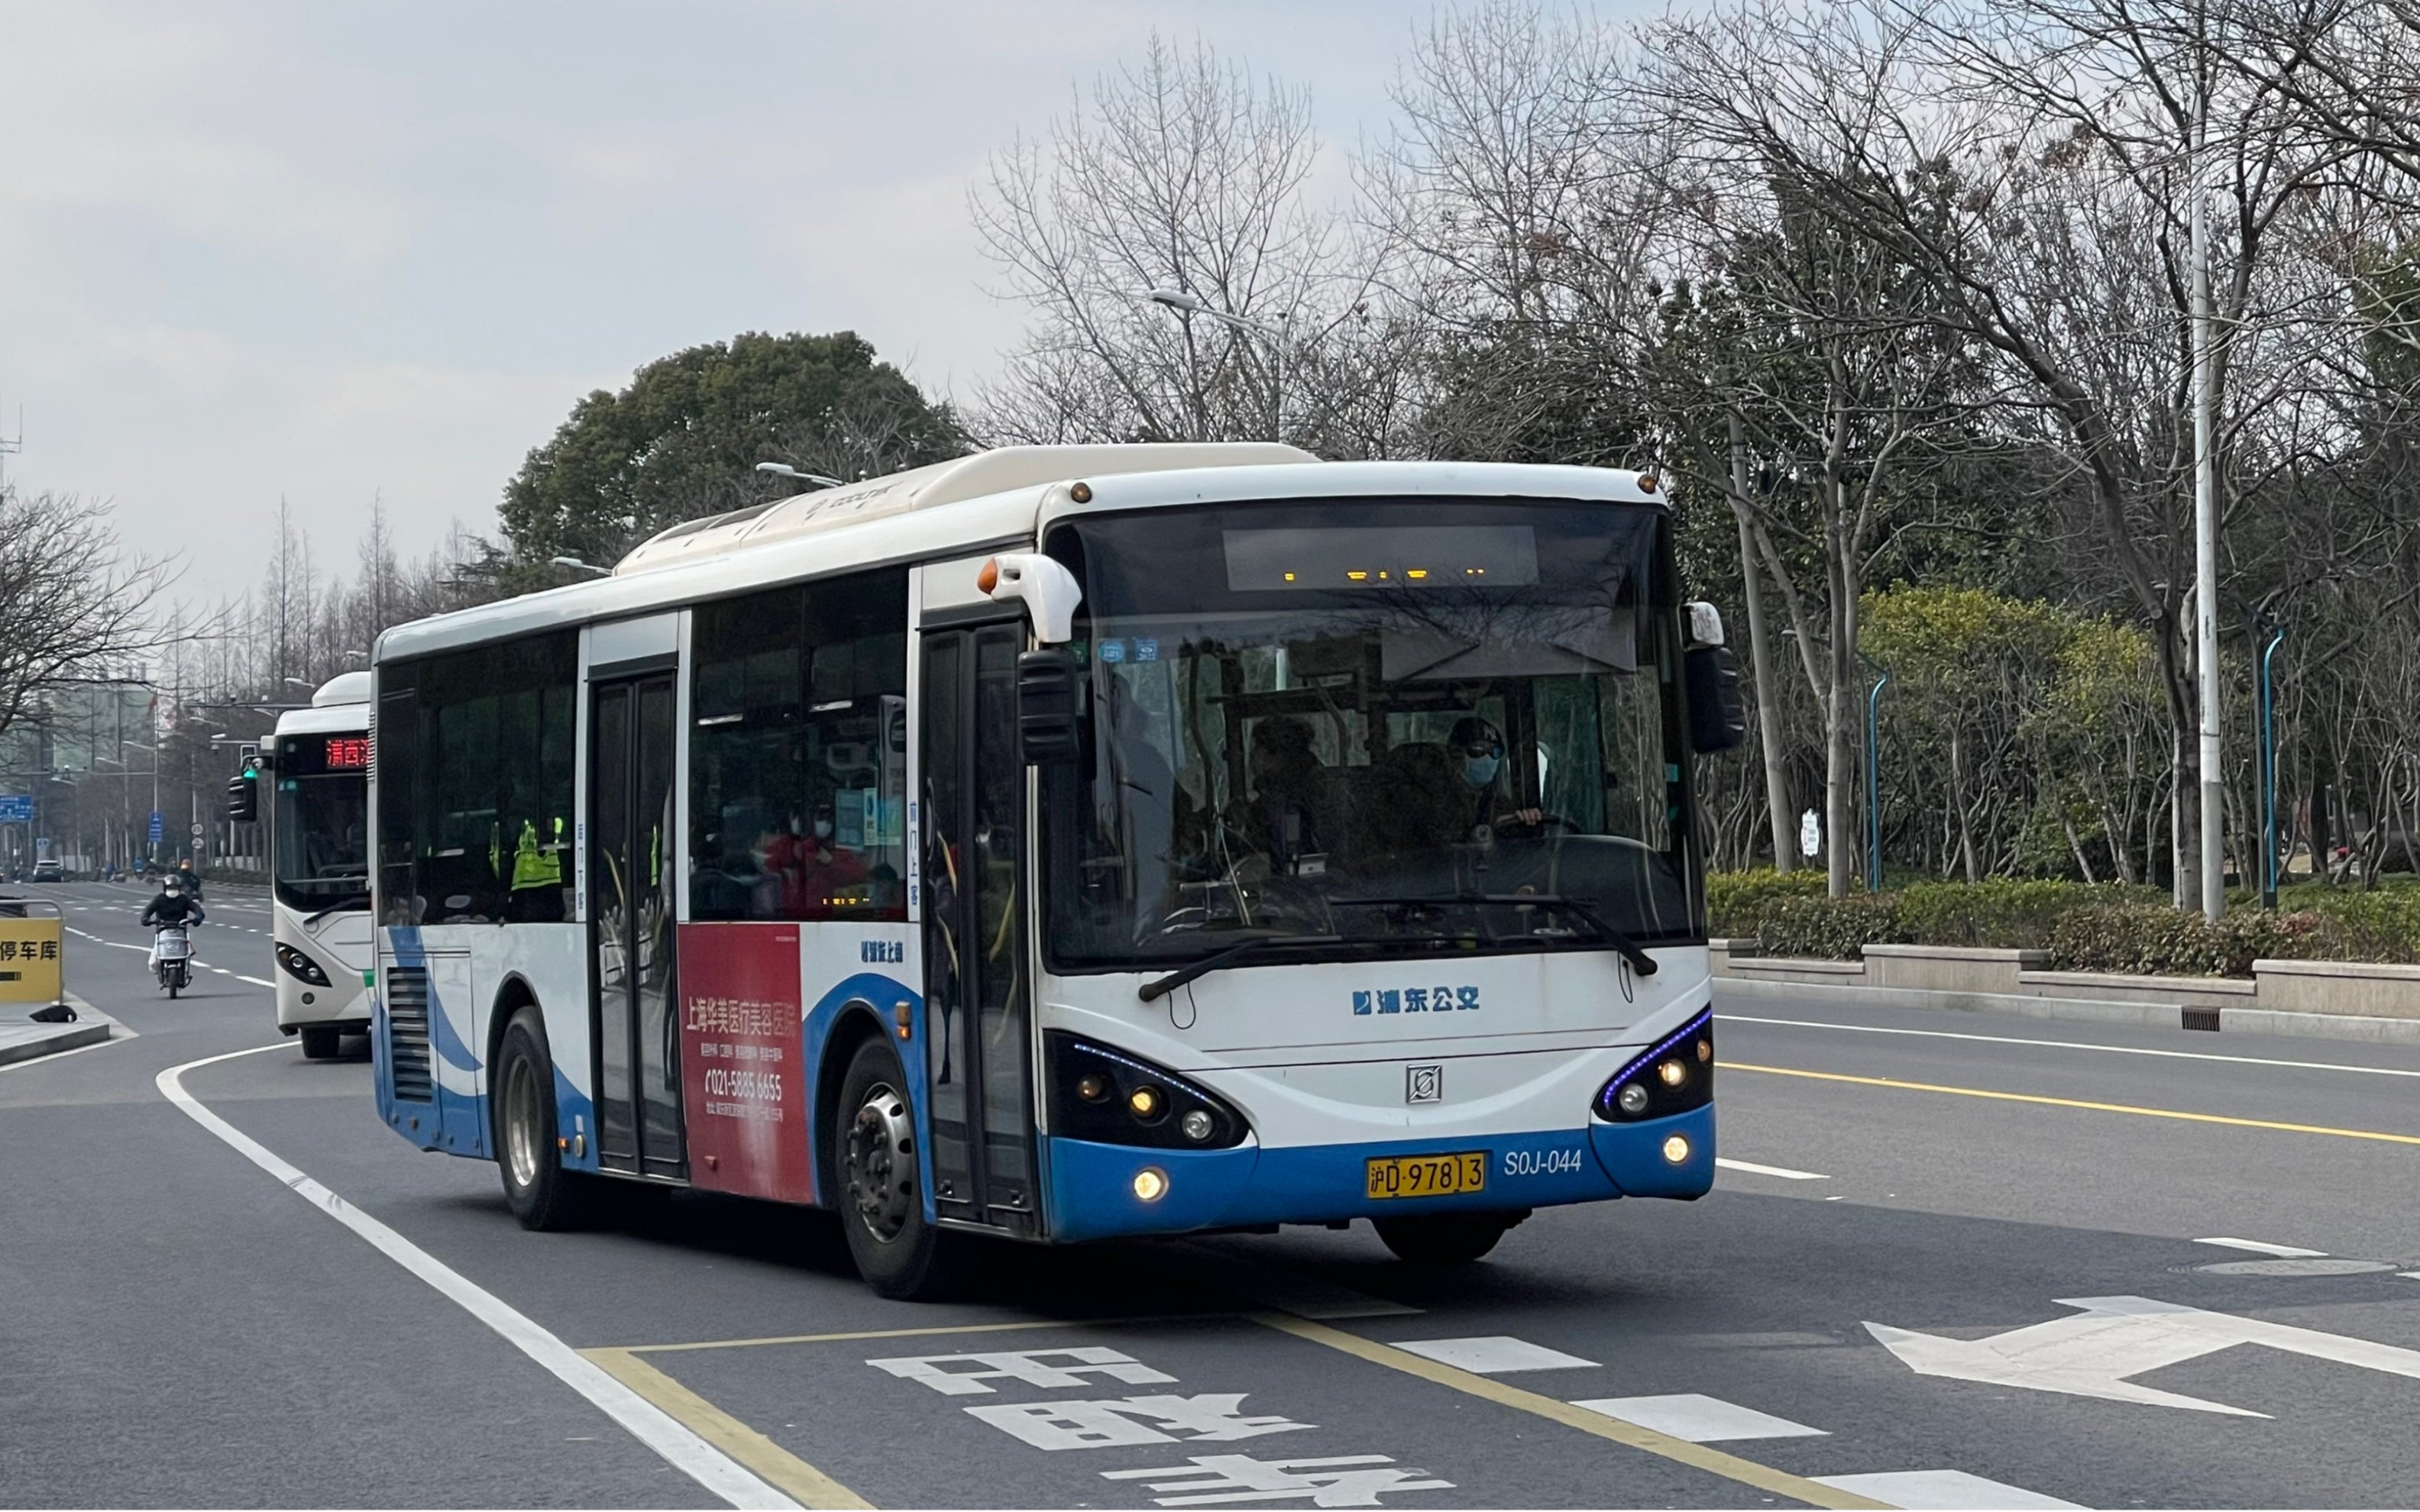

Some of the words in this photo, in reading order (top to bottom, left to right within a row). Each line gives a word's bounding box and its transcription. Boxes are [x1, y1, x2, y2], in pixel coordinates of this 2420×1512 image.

[0, 940, 57, 961] 停车库
[1376, 986, 1480, 1015] 浦东公交
[687, 996, 795, 1037] 上海华美医疗美容医院
[757, 1072, 781, 1101] 6655
